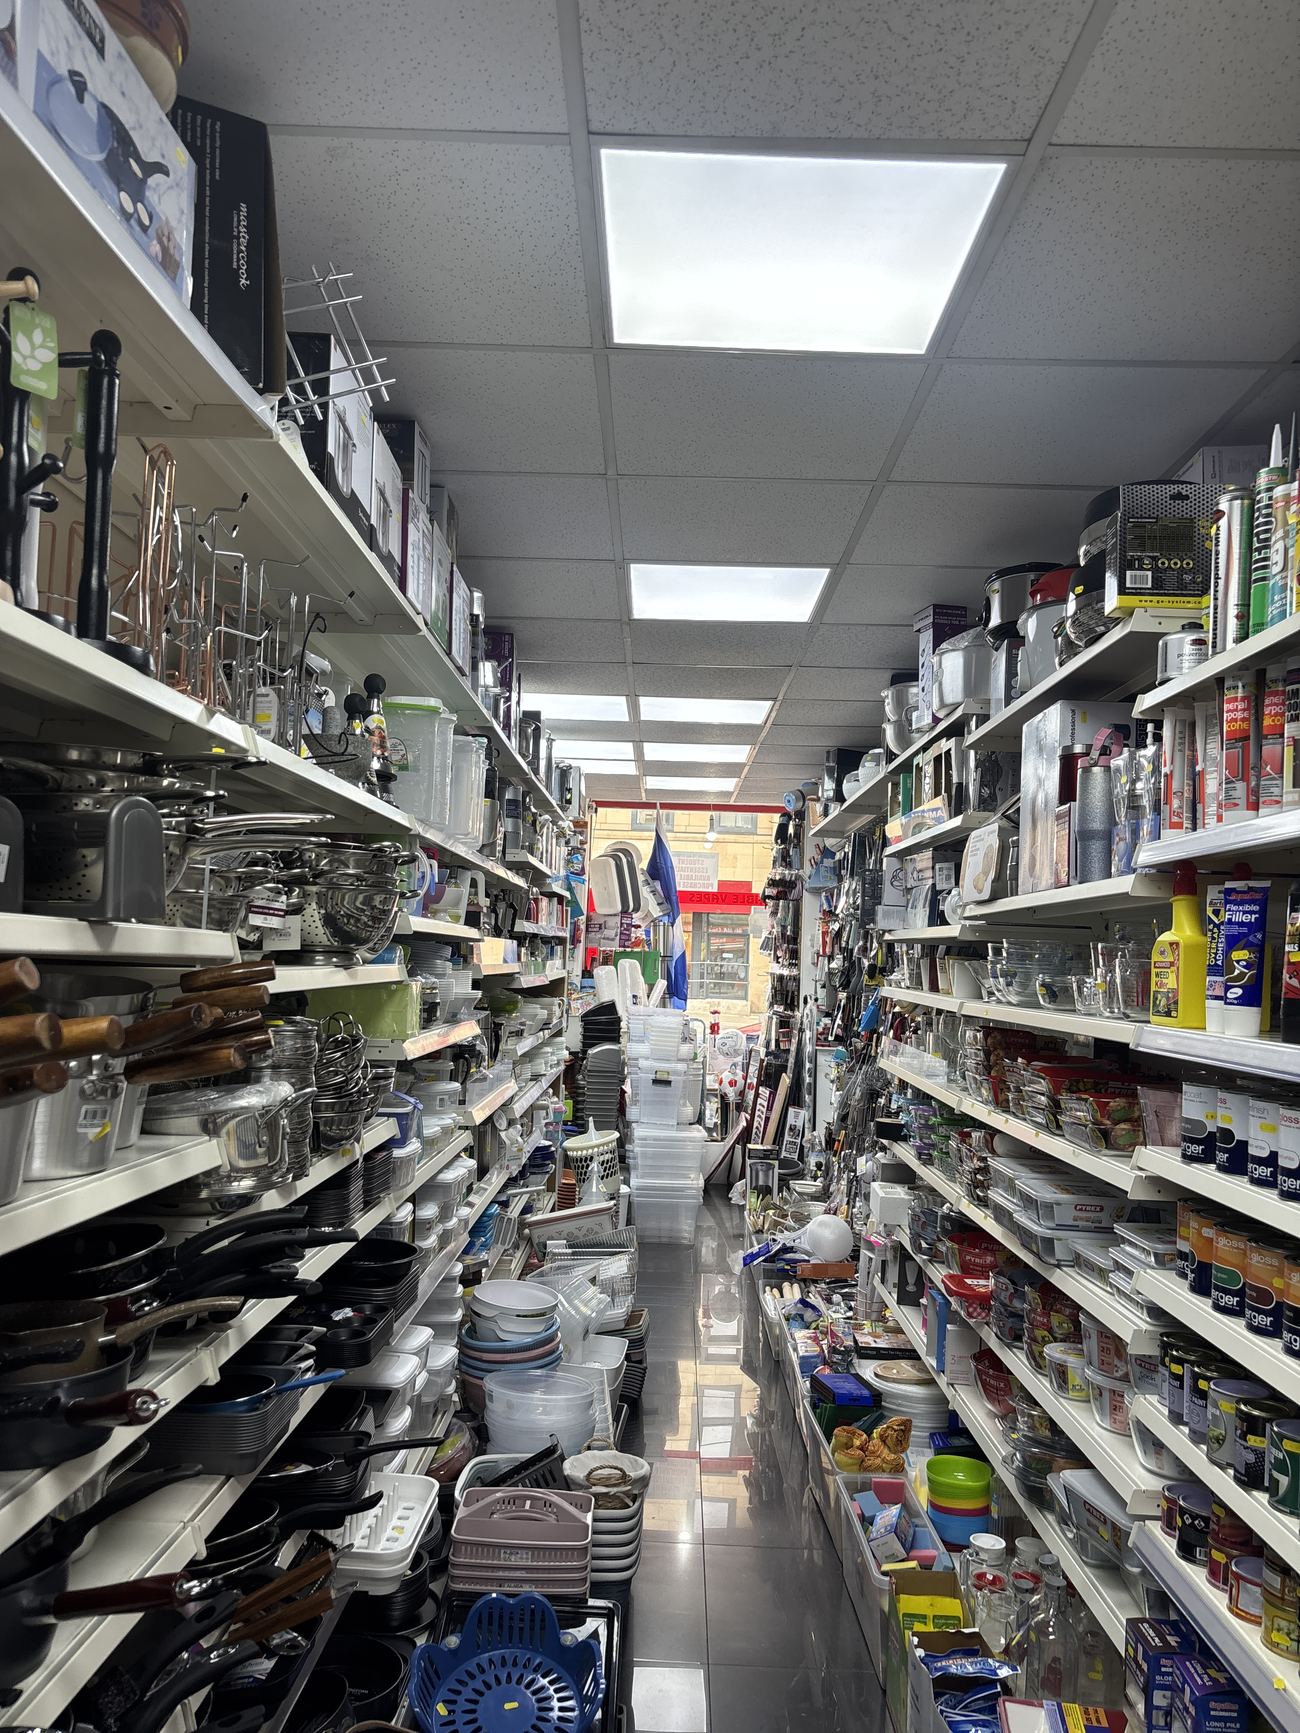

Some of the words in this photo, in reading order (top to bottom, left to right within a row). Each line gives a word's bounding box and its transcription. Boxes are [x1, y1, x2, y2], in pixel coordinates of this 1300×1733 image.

[240, 202, 250, 290] mastercook
[1213, 548, 1221, 601] Propane
[1138, 598, 1202, 606] www.go-system.co
[1211, 602, 1219, 649] Butane
[1225, 700, 1248, 711] neral
[1225, 711, 1249, 720] rpose
[1069, 708, 1077, 745] rofessional
[1225, 911, 1260, 922] Filler
[1210, 927, 1218, 965] OVERLAP
[1216, 925, 1225, 966] ADHESIVE
[1155, 970, 1170, 979] WEED
[1155, 980, 1168, 989] Killer
[1216, 1151, 1229, 1163] ger
[1278, 1174, 1300, 1191] rger
[965, 1255, 994, 1264] PYREX
[1176, 1259, 1190, 1273] erg
[1211, 1288, 1240, 1308] erger
[1245, 1308, 1274, 1326] erger
[1282, 1330, 1300, 1349] erg
[1136, 1359, 1158, 1370] PYRE
